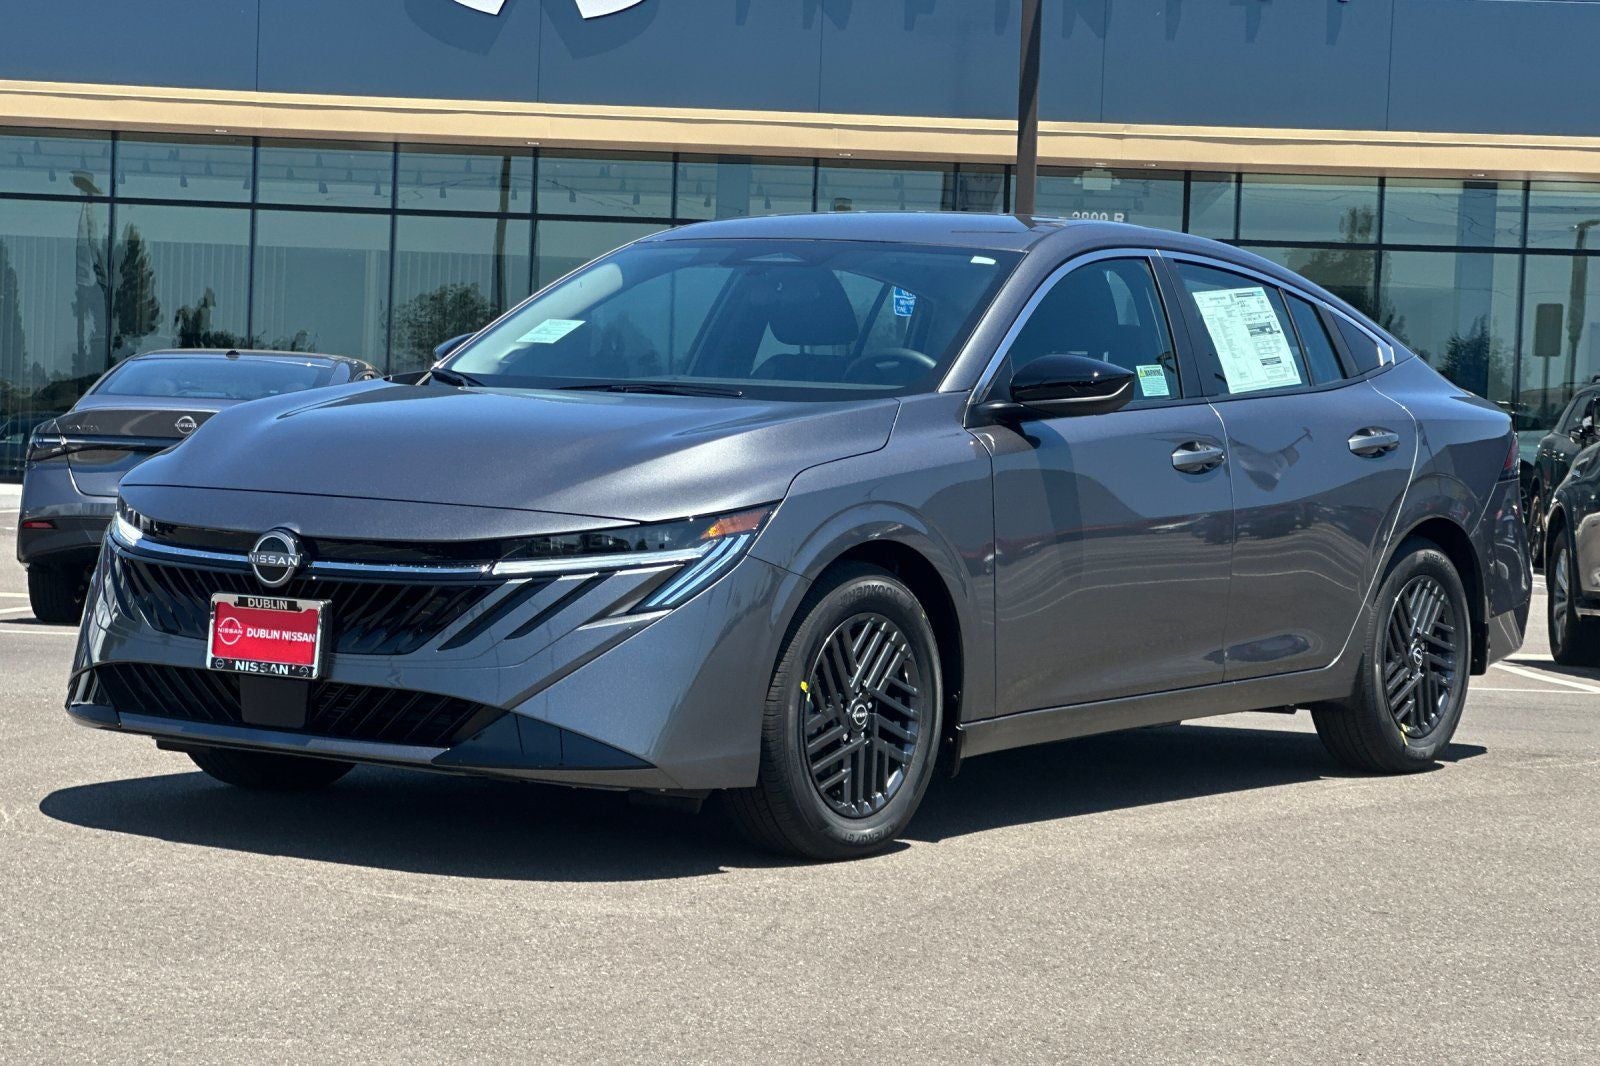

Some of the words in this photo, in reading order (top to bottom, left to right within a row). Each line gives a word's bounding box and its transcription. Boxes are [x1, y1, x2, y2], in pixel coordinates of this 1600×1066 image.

[250, 554, 298, 566] NISSAN
[247, 598, 288, 610] DUBLIN
[218, 627, 243, 635] NISSAN
[246, 627, 280, 639] DUBLIN
[282, 630, 315, 643] NISSAN
[235, 660, 289, 675] NISSAN
